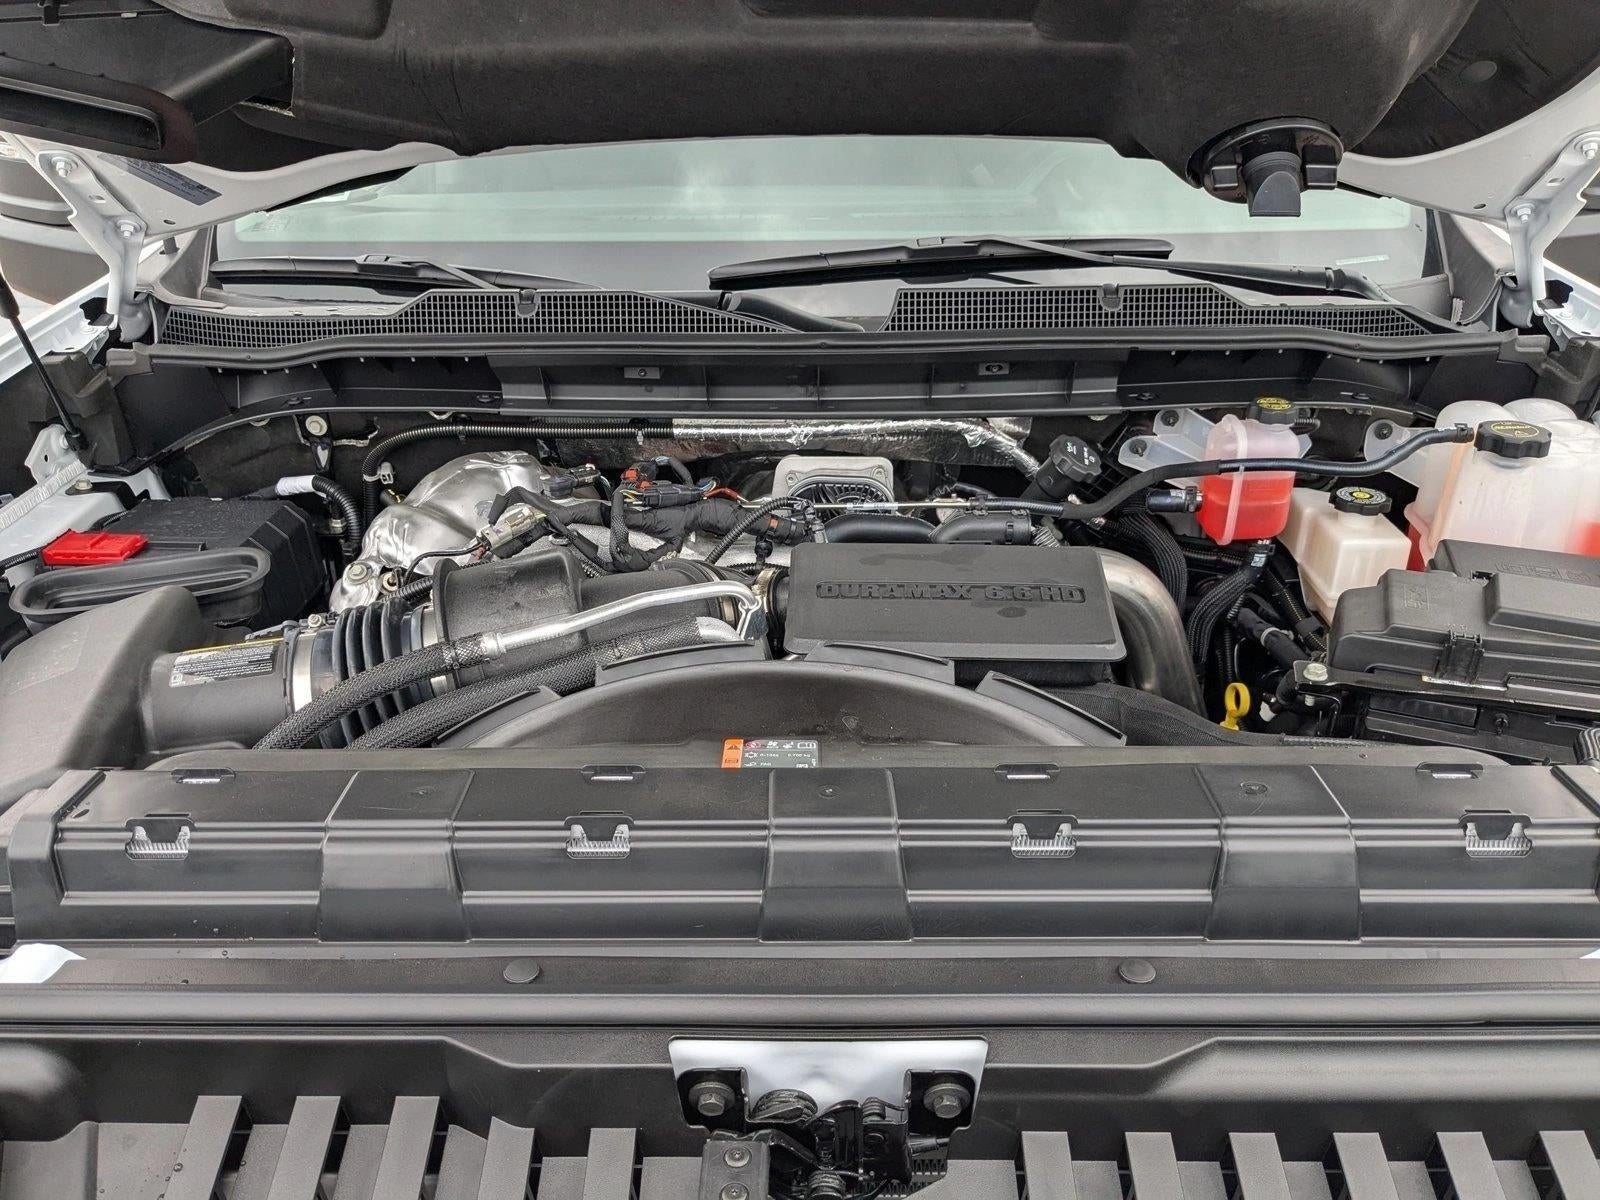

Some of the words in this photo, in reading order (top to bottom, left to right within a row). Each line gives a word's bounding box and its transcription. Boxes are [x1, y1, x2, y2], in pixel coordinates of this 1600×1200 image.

[817, 583, 972, 600] DURAMAX
[984, 584, 1032, 601] 6.6
[1040, 586, 1086, 603] HD
